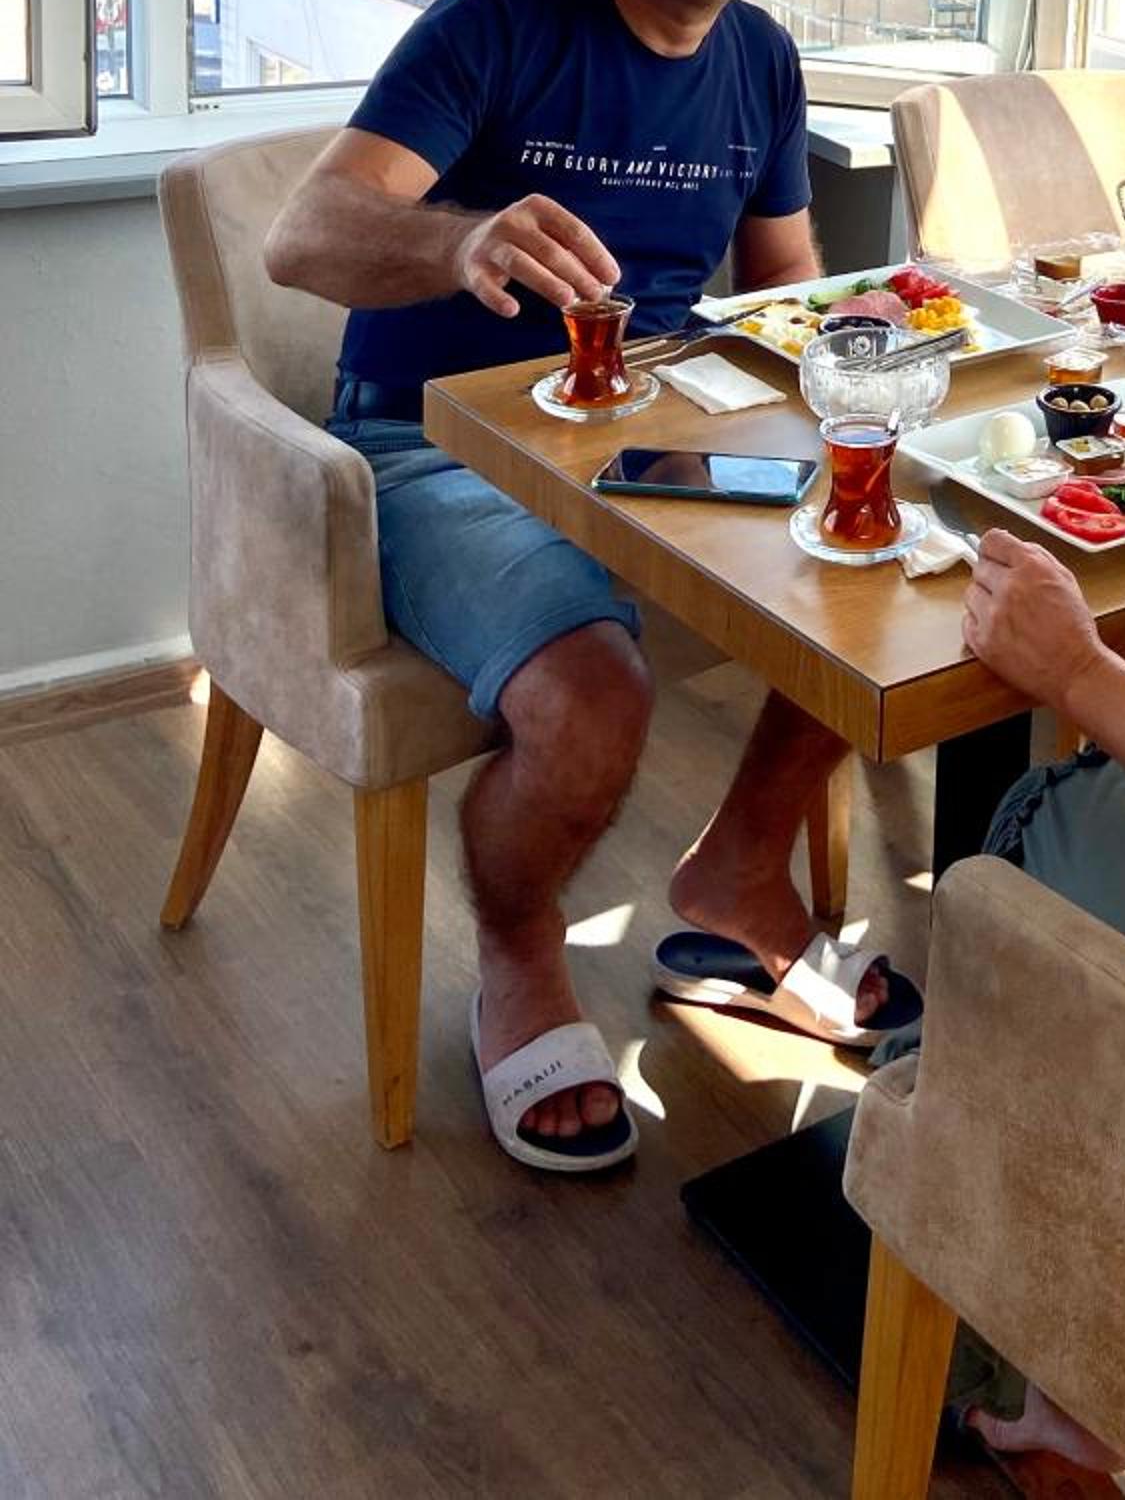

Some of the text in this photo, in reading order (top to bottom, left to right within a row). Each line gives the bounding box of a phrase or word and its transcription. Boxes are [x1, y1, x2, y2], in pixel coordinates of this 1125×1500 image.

[520, 149, 556, 167] FOR
[564, 155, 619, 174] GLORY
[625, 160, 653, 175] AND
[658, 160, 719, 178] VICTORY
